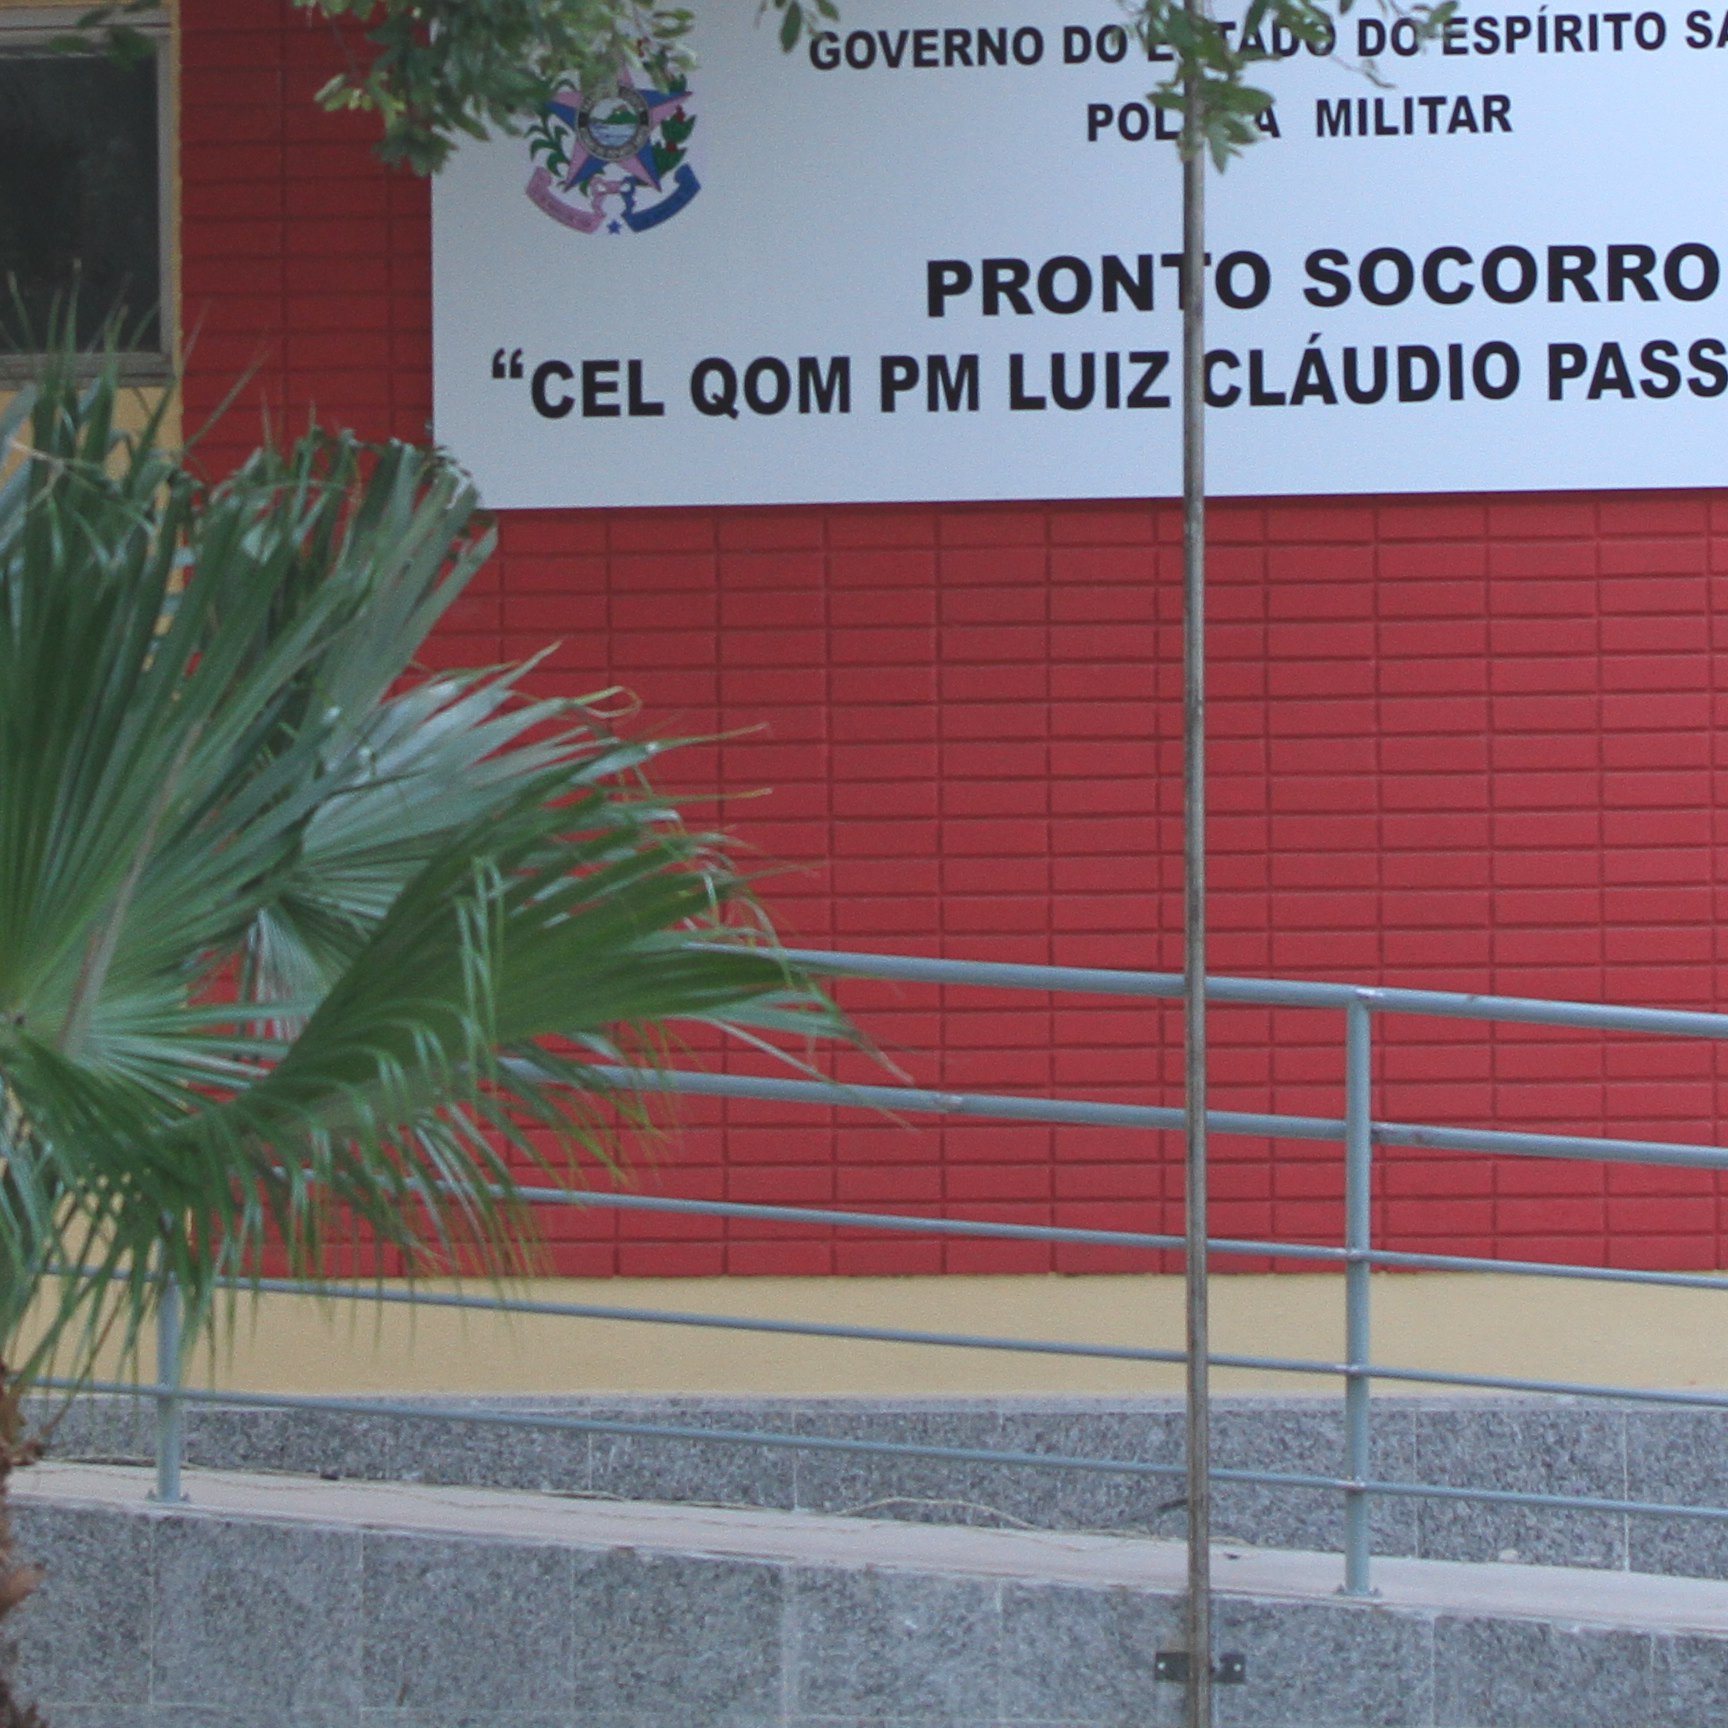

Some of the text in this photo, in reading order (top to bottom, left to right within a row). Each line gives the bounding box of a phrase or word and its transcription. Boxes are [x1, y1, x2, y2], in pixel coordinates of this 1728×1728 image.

[808, 25, 1044, 71] GOVERNO
[1063, 24, 1128, 64] DO
[1358, 17, 1420, 57] DO
[1441, 4, 1667, 55] ESPÍRITO
[1087, 95, 1512, 142] POLA MILITAR
[927, 242, 1720, 318] PRONTO SOCORRO
[491, 348, 665, 419] “CEL
[690, 355, 851, 420] QOM
[879, 354, 979, 413] PM
[1009, 350, 1171, 411] LUIZ
[1203, 332, 1520, 408] CLÁUDIO
